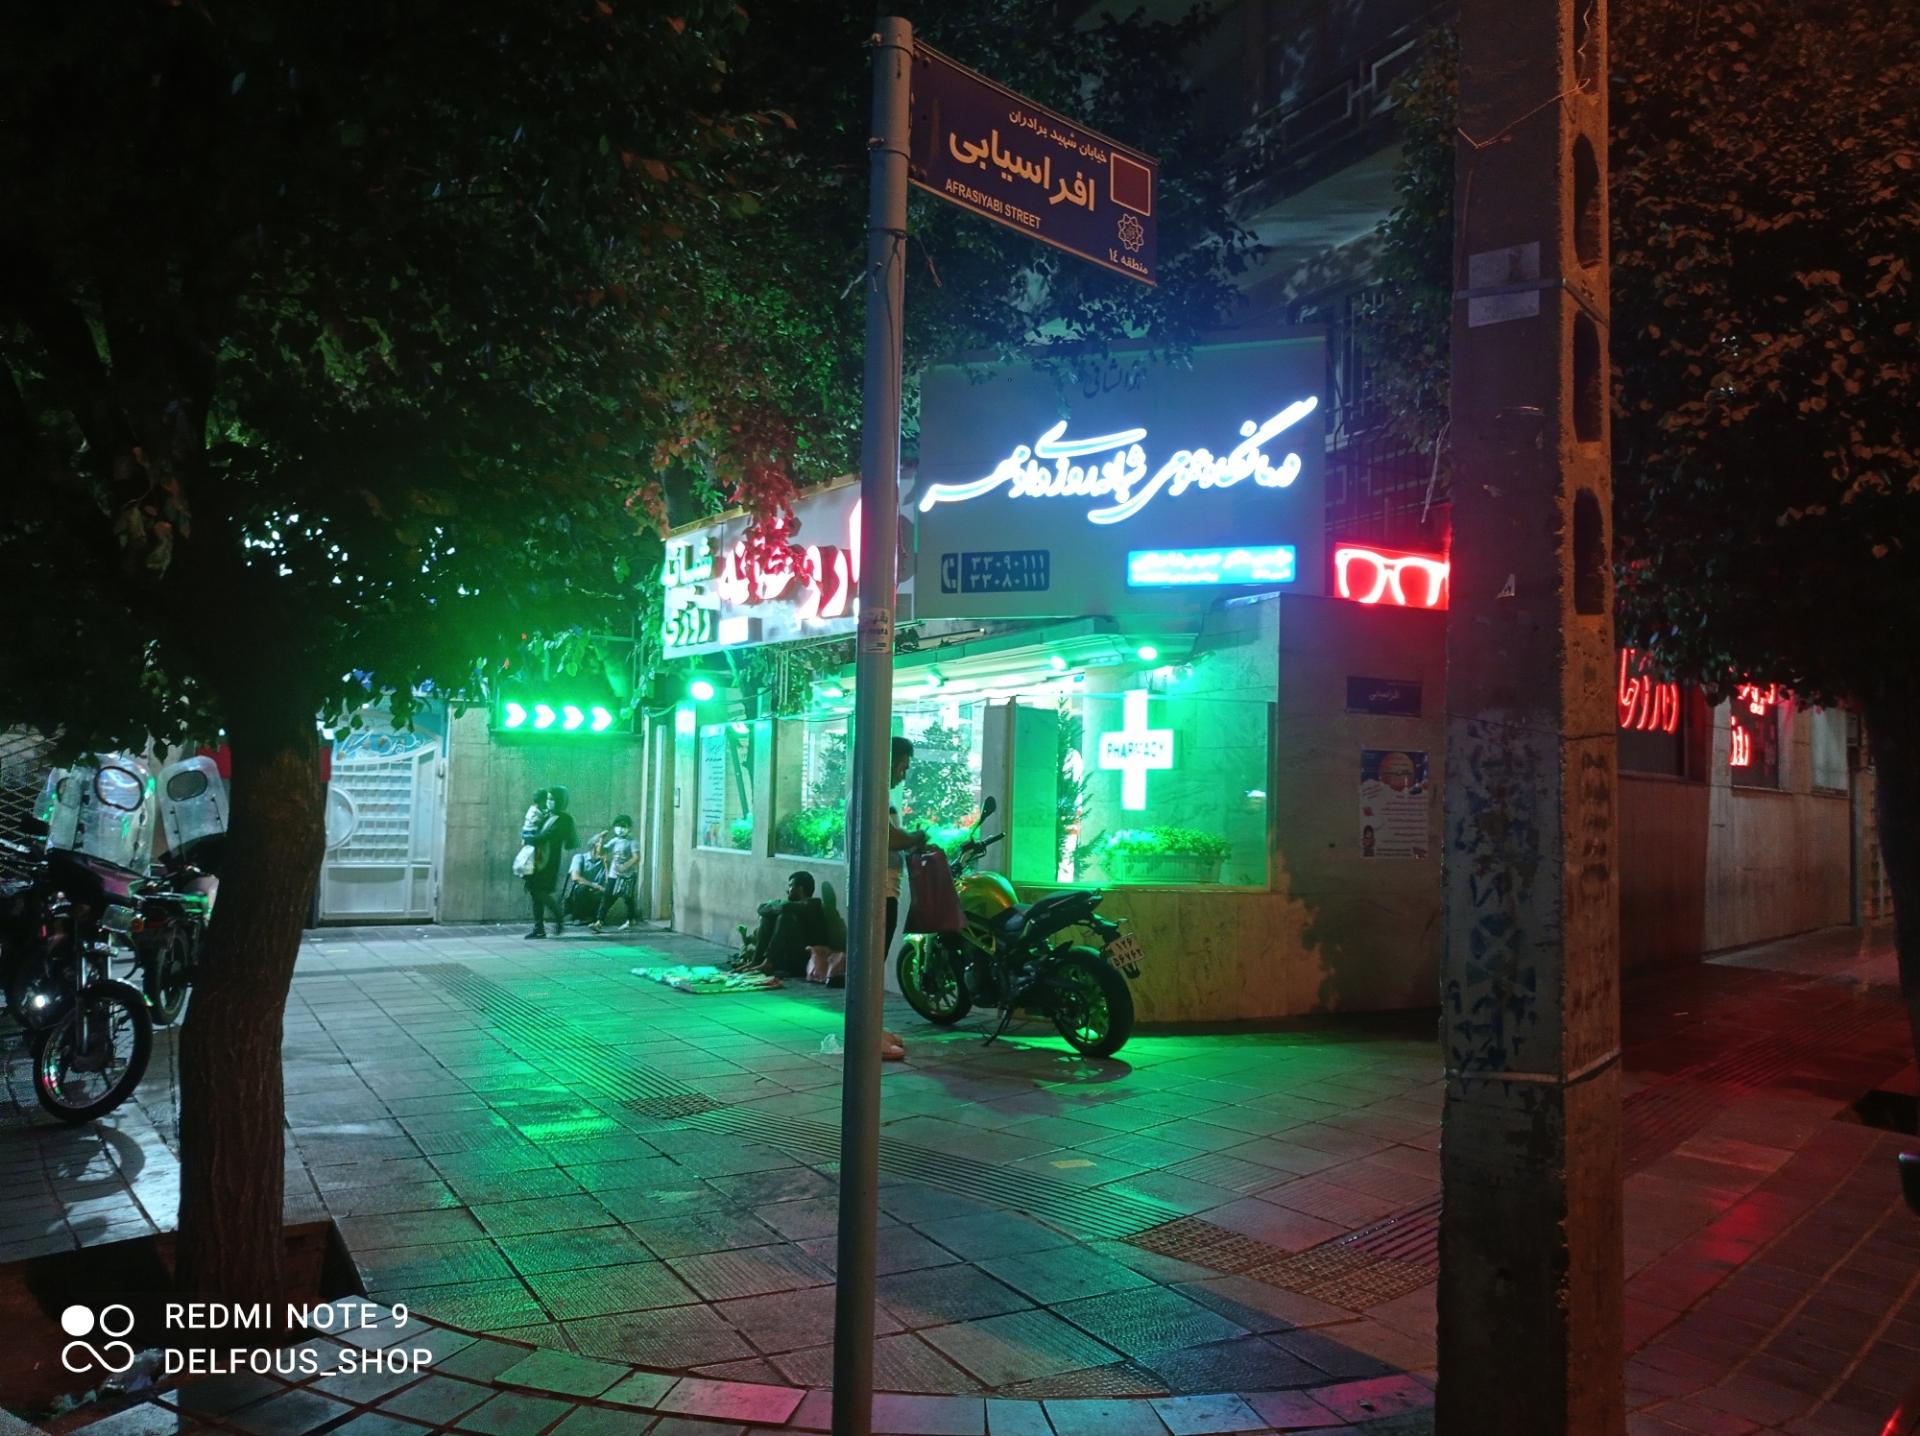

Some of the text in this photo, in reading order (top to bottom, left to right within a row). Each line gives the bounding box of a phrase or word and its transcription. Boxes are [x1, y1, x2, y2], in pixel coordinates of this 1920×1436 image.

[1008, 110, 1107, 163] خیابان شهید برادران
[949, 129, 1095, 212] افراسیابی
[945, 178, 1041, 229] AFRASIYABI STREET
[1120, 255, 1149, 275] منطقه
